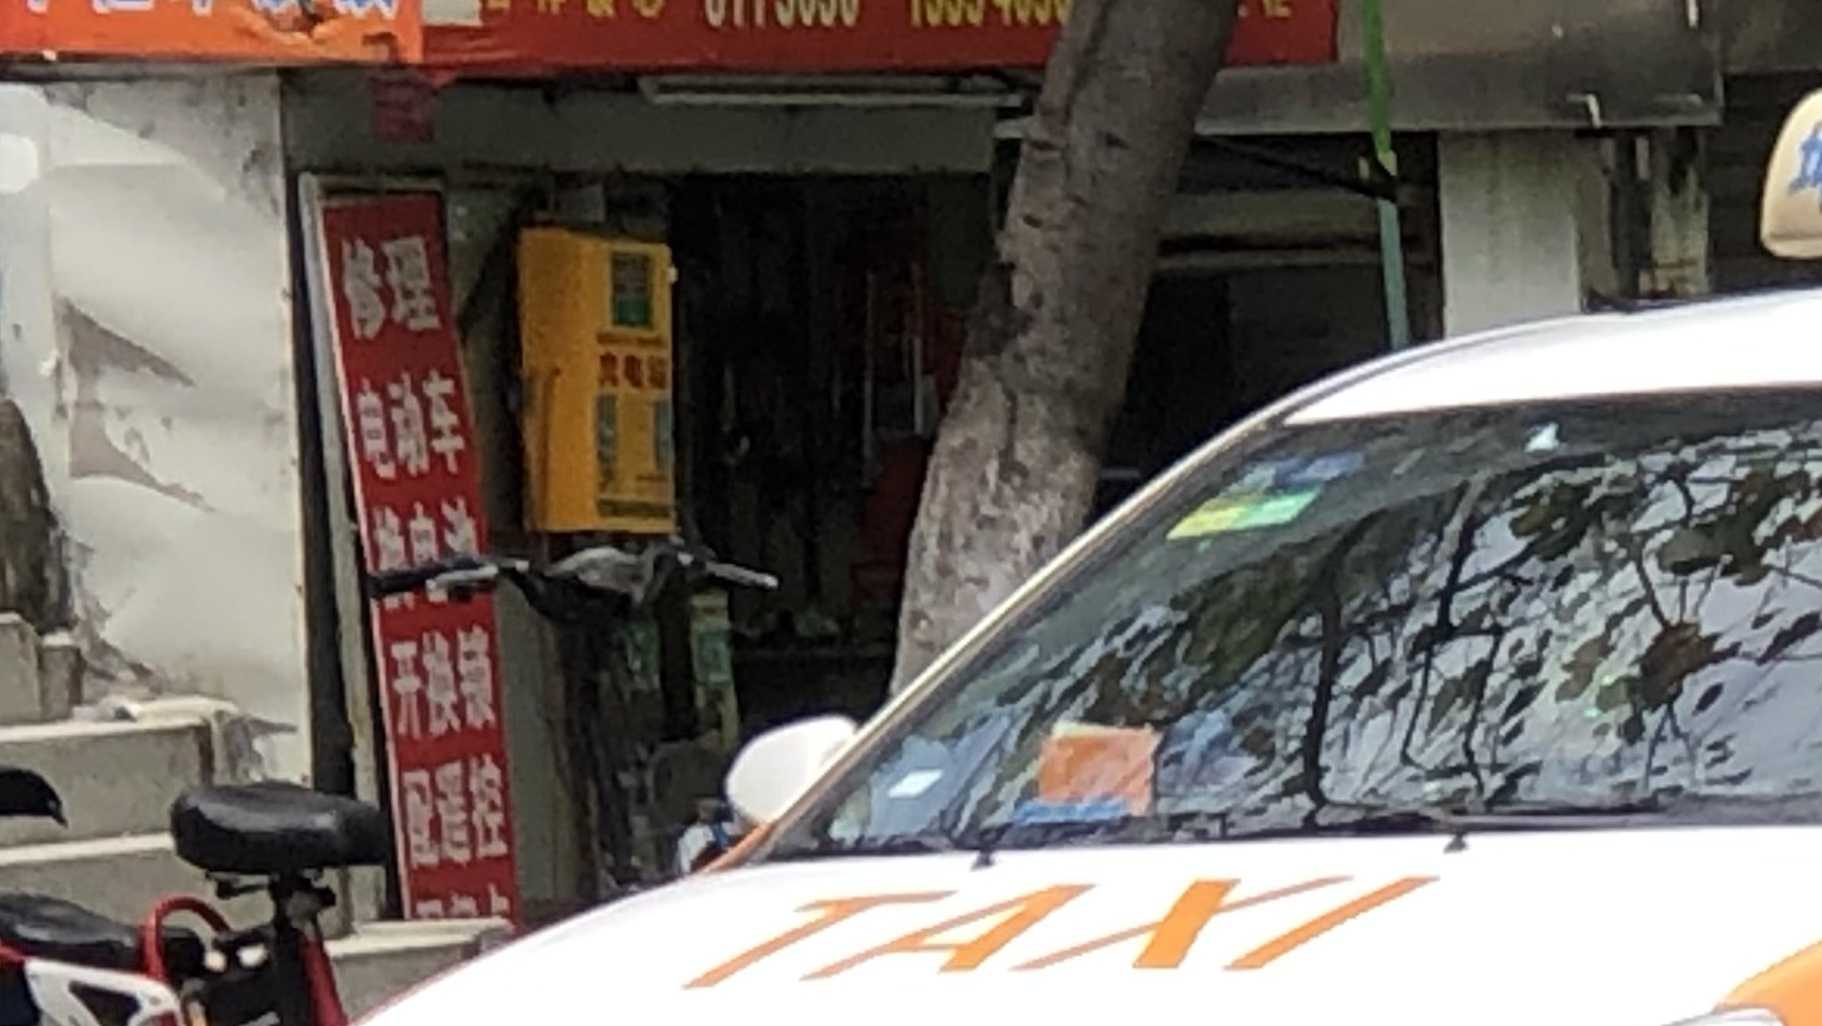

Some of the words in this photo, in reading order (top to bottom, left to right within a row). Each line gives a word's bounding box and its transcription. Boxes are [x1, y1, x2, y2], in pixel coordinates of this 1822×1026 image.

[341, 235, 442, 341] 修理
[357, 367, 466, 480] 电动车
[402, 752, 509, 868] 配遥控
[682, 874, 1440, 990] TAXI
